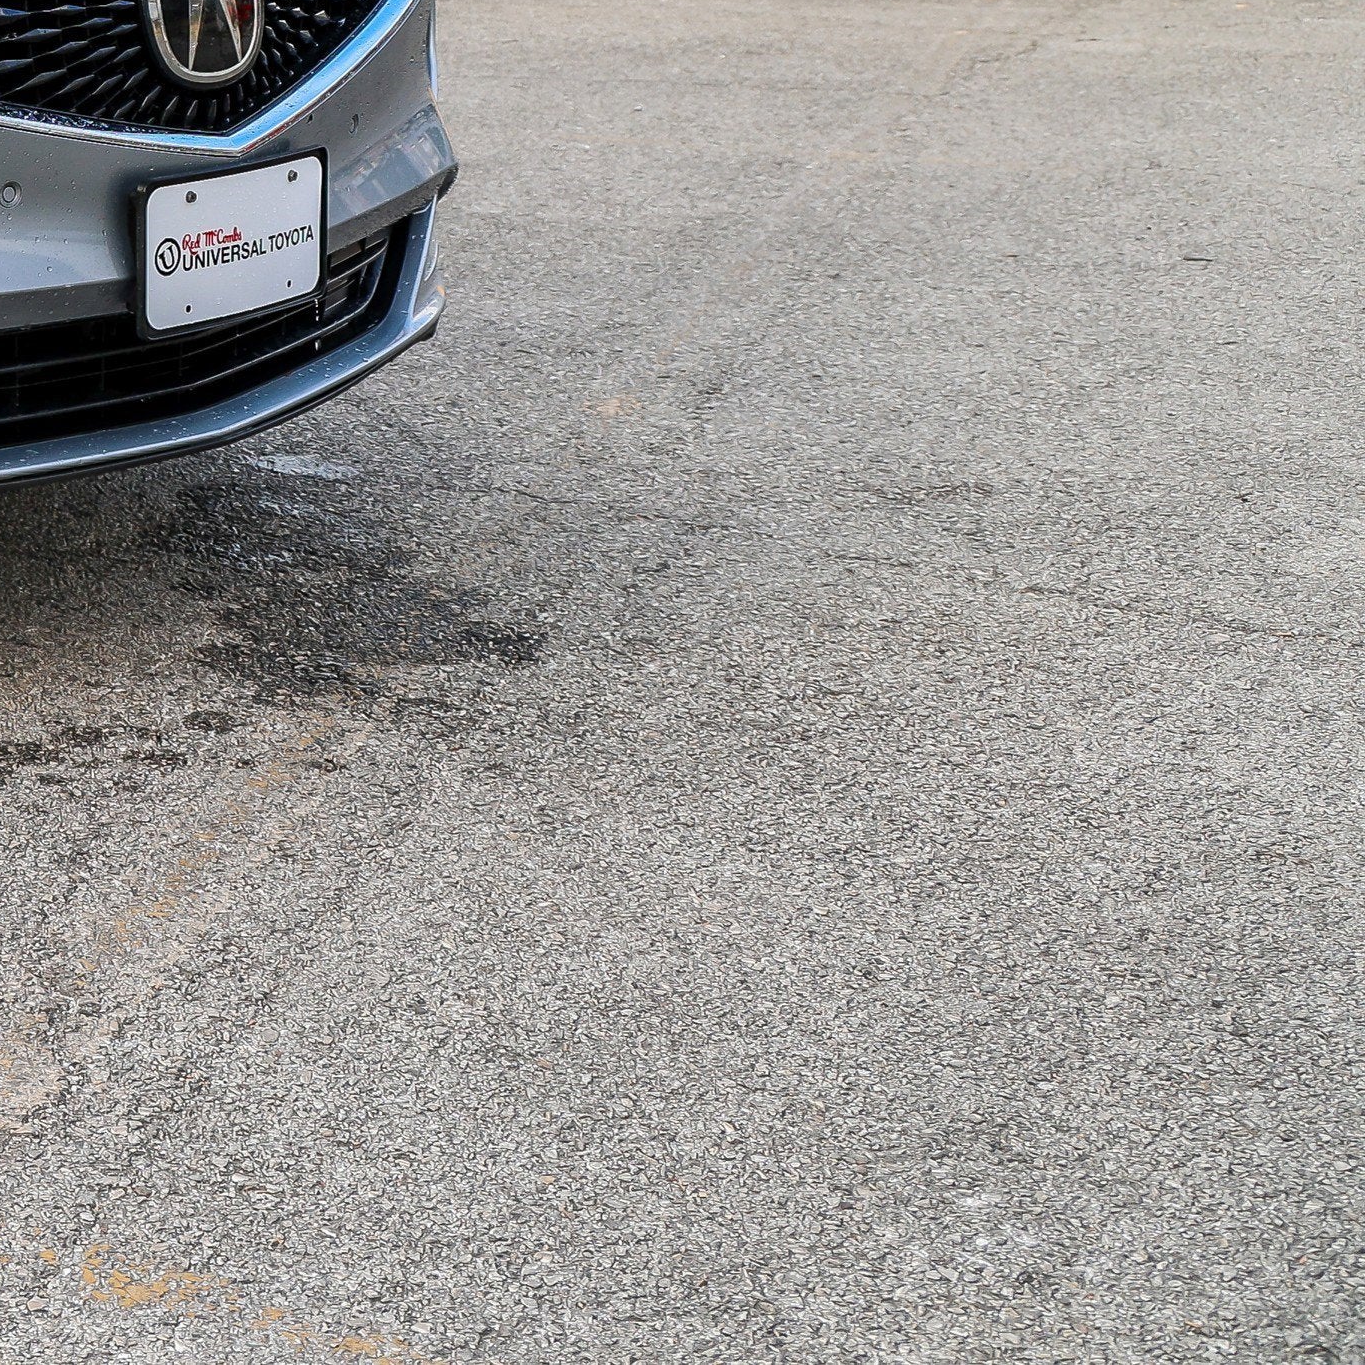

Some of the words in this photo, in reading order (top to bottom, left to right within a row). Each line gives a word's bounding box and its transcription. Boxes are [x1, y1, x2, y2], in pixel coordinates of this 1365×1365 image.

[182, 233, 201, 255] Red
[182, 239, 266, 271] UNIVERSAL
[268, 225, 314, 251] TOYOTA
